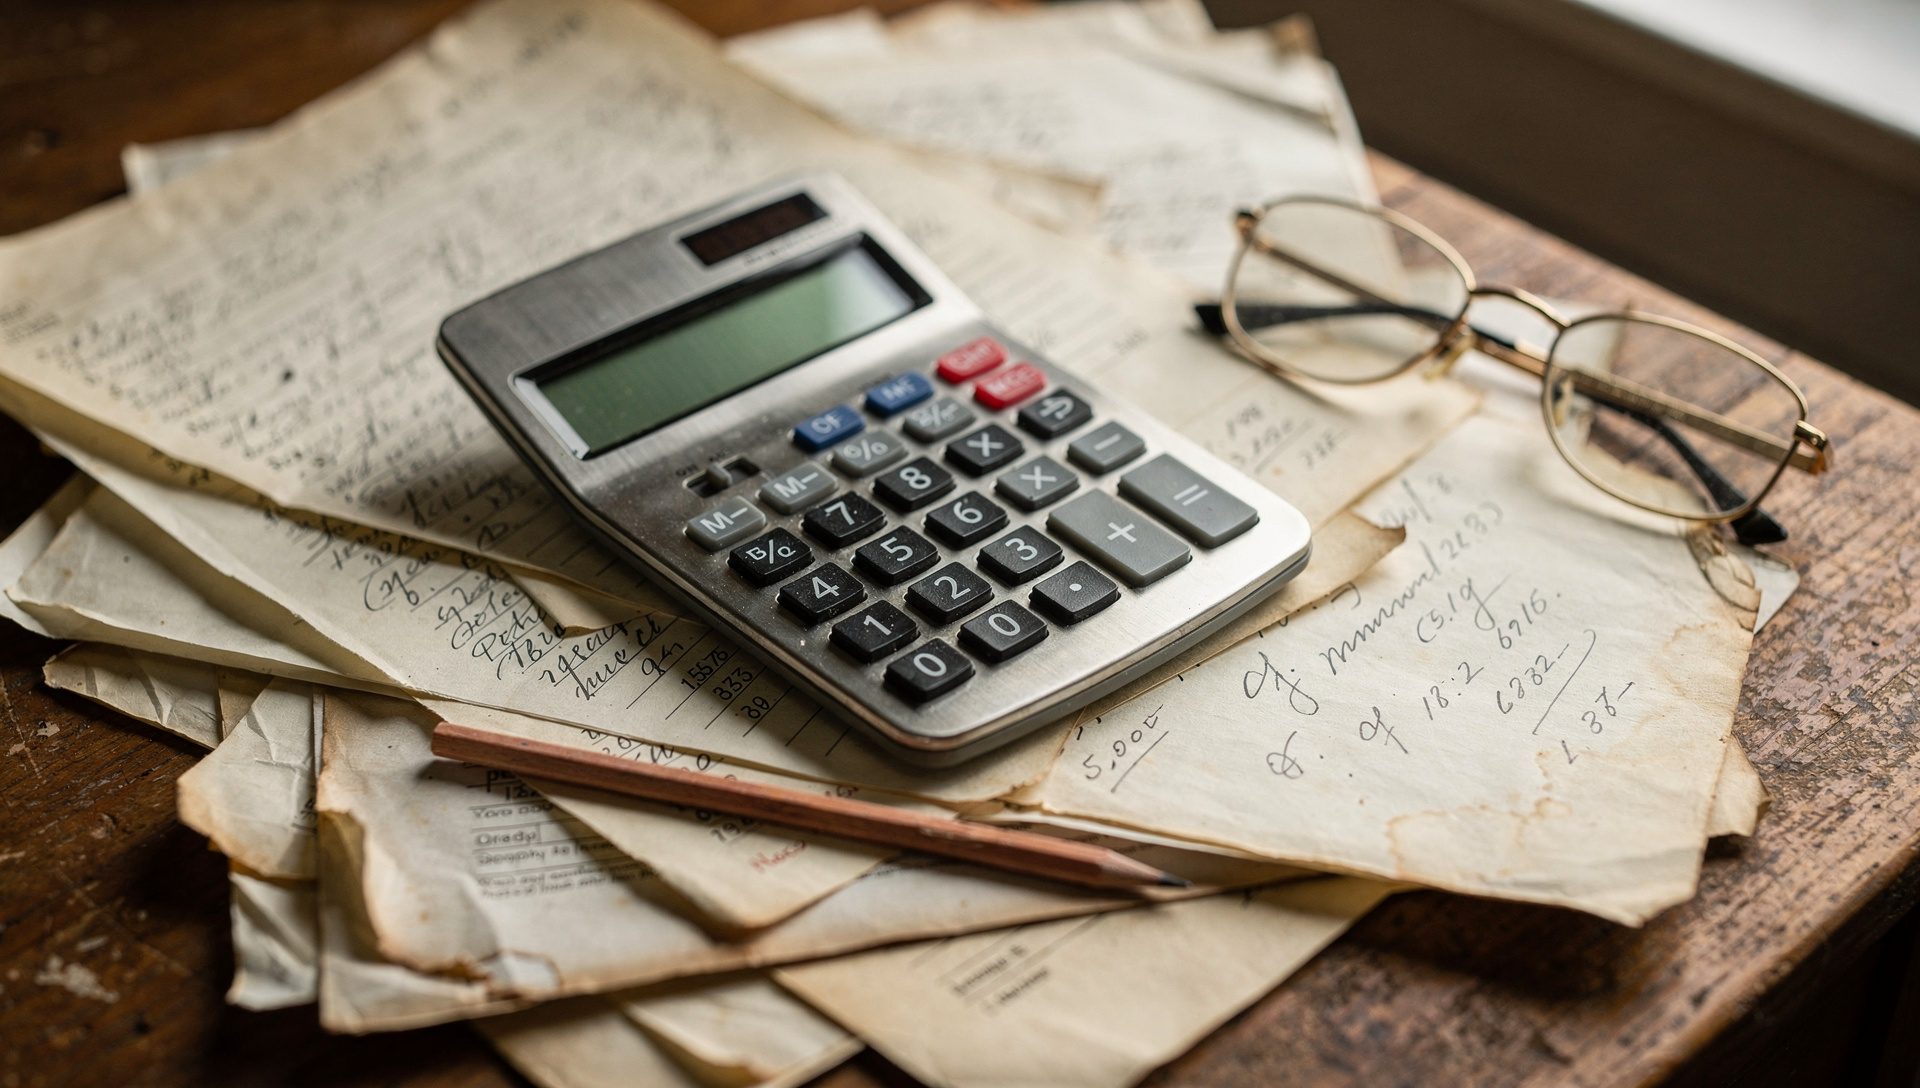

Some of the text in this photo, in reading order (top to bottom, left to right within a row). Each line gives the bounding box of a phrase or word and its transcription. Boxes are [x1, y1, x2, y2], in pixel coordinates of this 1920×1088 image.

[899, 466, 932, 490] 8
[824, 501, 855, 526] 7
[953, 500, 984, 524] 6
[880, 536, 914, 561] 5
[1004, 537, 1038, 562] 3
[811, 576, 840, 600] 4
[934, 575, 971, 600] 2
[863, 613, 892, 636] 1
[987, 612, 1021, 637] 0
[913, 652, 947, 678] 0
